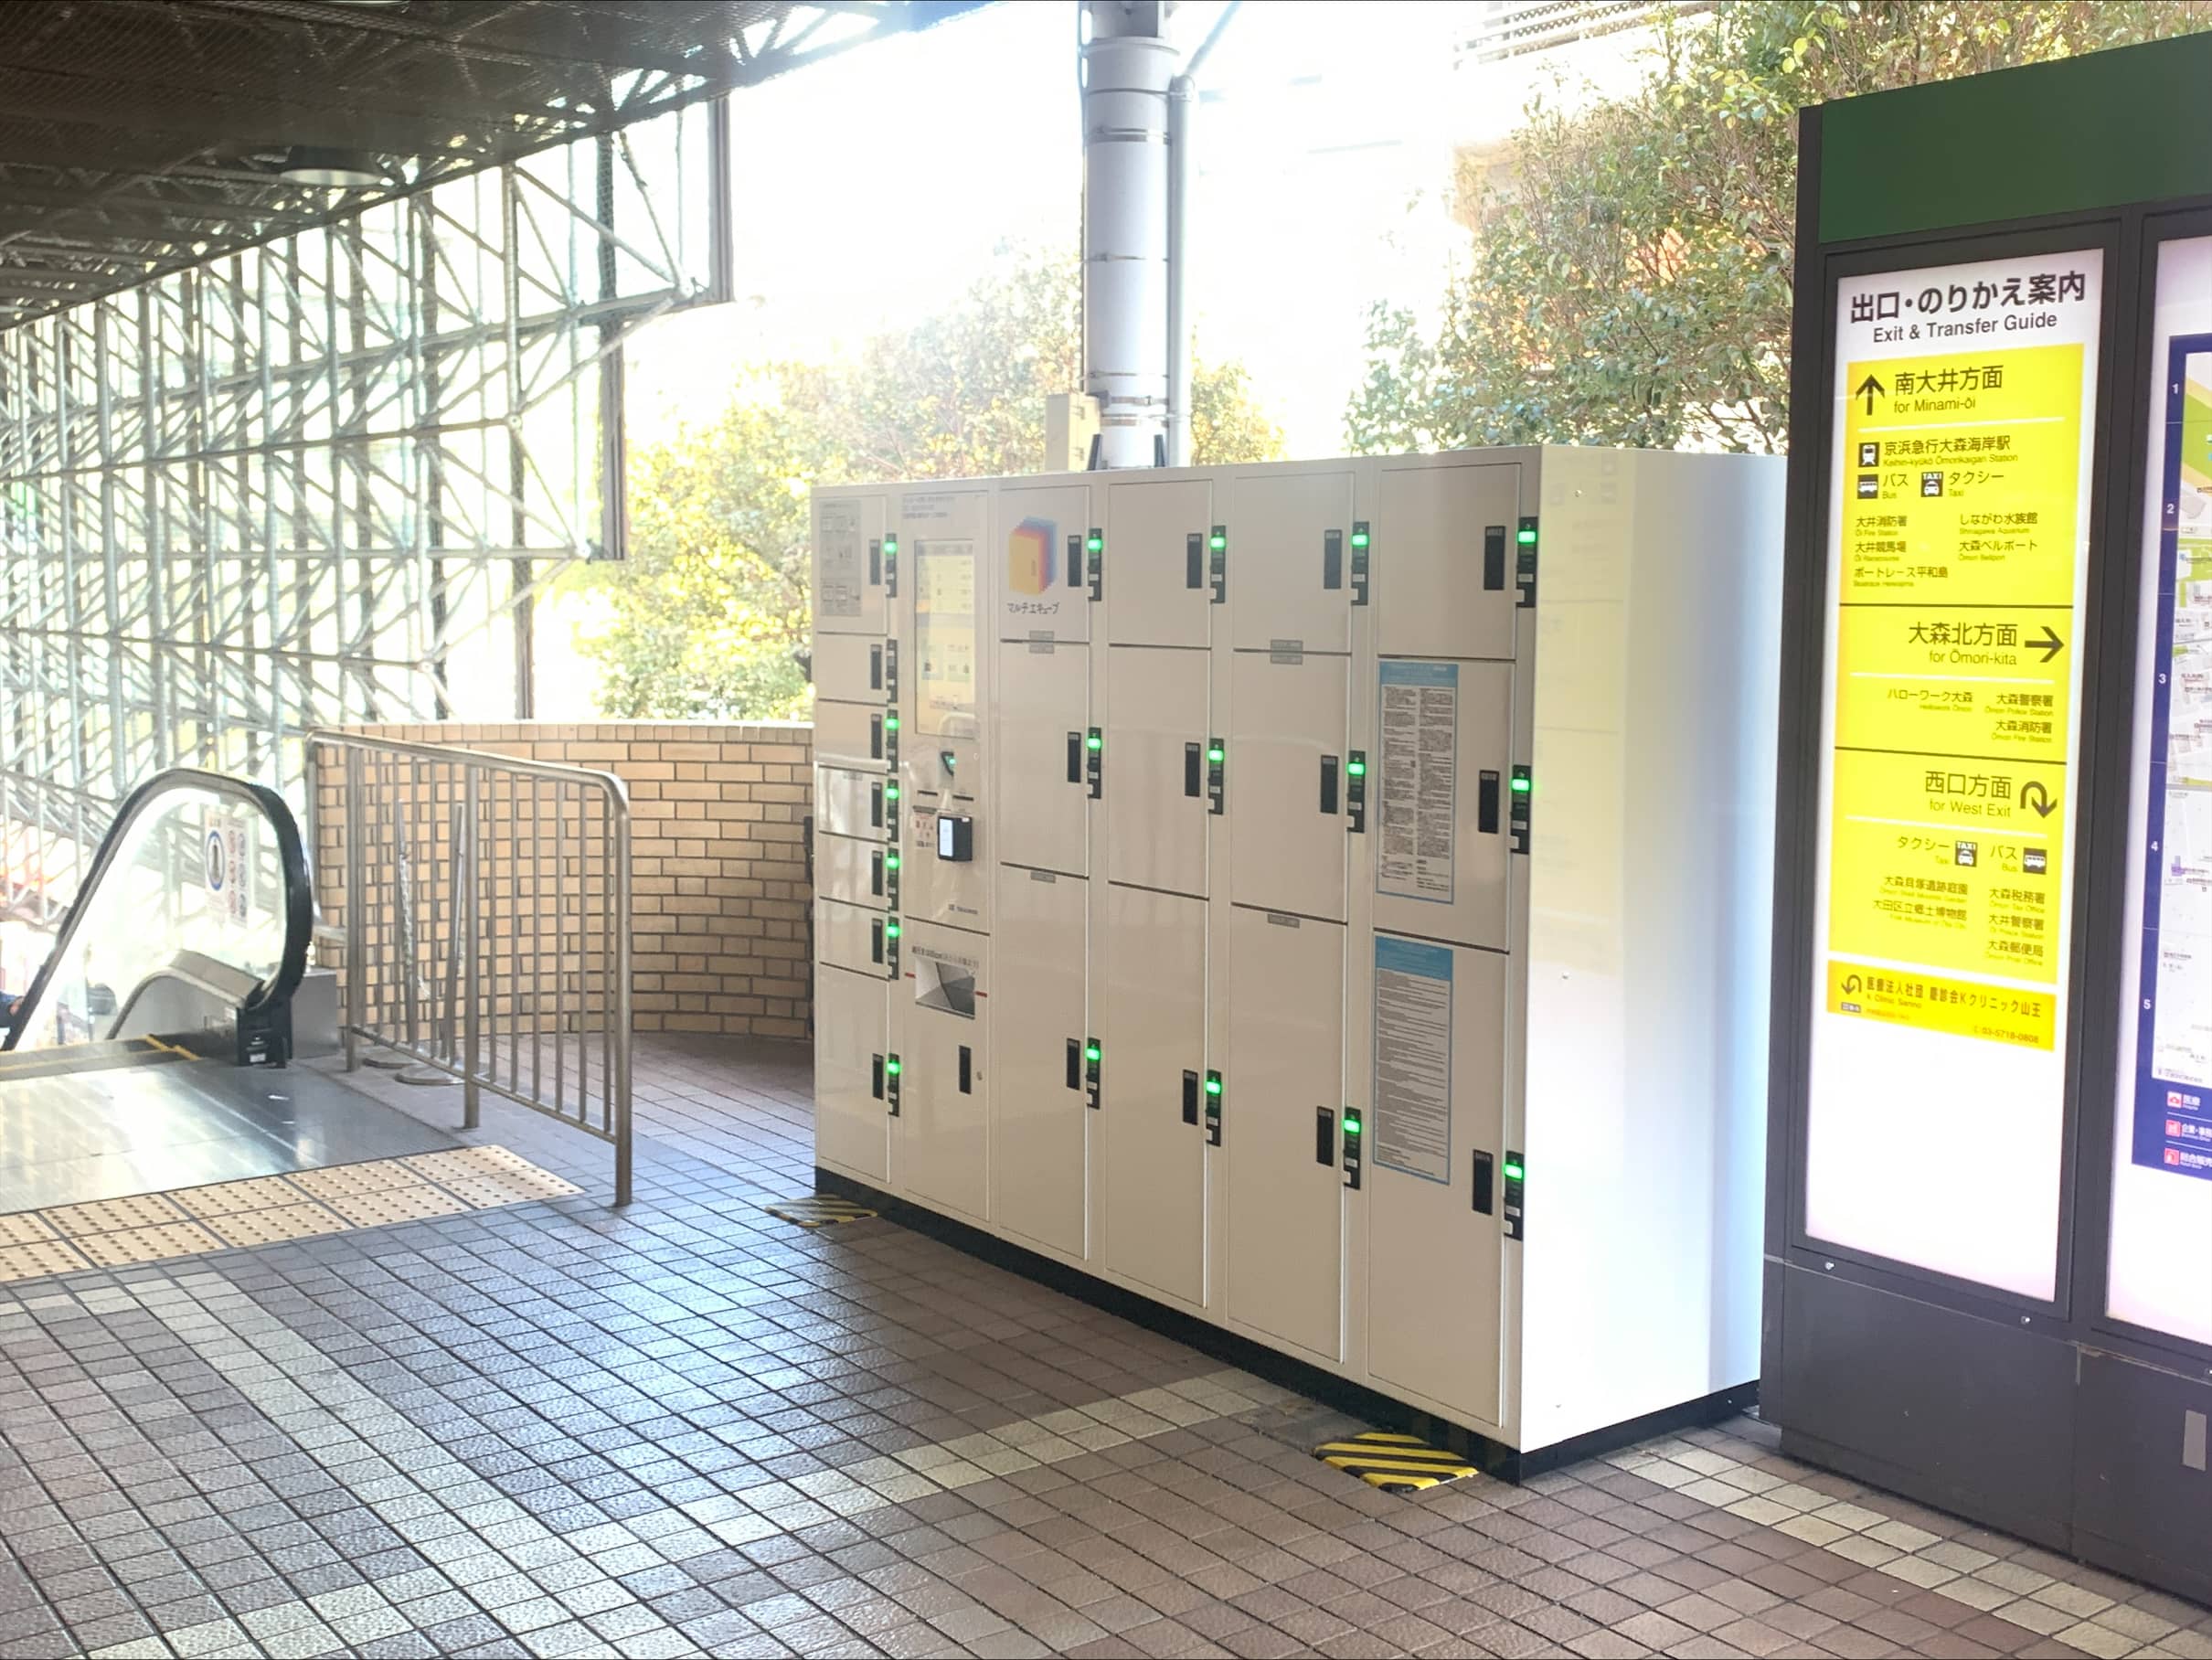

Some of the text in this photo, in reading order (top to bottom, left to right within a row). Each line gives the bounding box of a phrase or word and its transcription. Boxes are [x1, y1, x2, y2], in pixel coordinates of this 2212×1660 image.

[1850, 271, 2086, 324] 出口・のりかえ案内
[1874, 312, 2058, 343] Exit & Transfer Guide
[1895, 365, 2005, 396] 南大井方面
[2173, 384, 2179, 394] 1
[1894, 399, 1910, 414] for
[1884, 435, 2011, 455] 京浜急行大森海岸駅
[1989, 452, 2019, 463] Station
[1883, 474, 1909, 487] バス
[1923, 473, 1942, 481] TAXI
[1948, 471, 2004, 485] タクシー
[1882, 490, 1897, 499] Bus
[2166, 504, 2175, 515] 2
[1959, 512, 2038, 526] しながわ水族館
[1959, 539, 2037, 551] 大森ベルポート
[1854, 566, 1949, 578] ボートレース平和島
[1909, 622, 2018, 646] 大森北方面
[1930, 650, 1945, 663] for
[2158, 674, 2166, 684] 3
[1888, 689, 1973, 703] ハローワーク大森
[1996, 694, 2053, 707] 大森警察署
[1996, 719, 2052, 734] 大森消防署
[1925, 771, 2012, 799] 西口方面
[1930, 800, 2011, 817] for West Exit
[1898, 836, 1950, 850] タクシー
[2151, 841, 2159, 851] 4
[1990, 845, 2018, 860] バス
[1989, 888, 2046, 904] 大森税務署
[1988, 941, 2044, 957] 大森郵便局
[1930, 986, 2041, 1017] 診会Kクリニック山王
